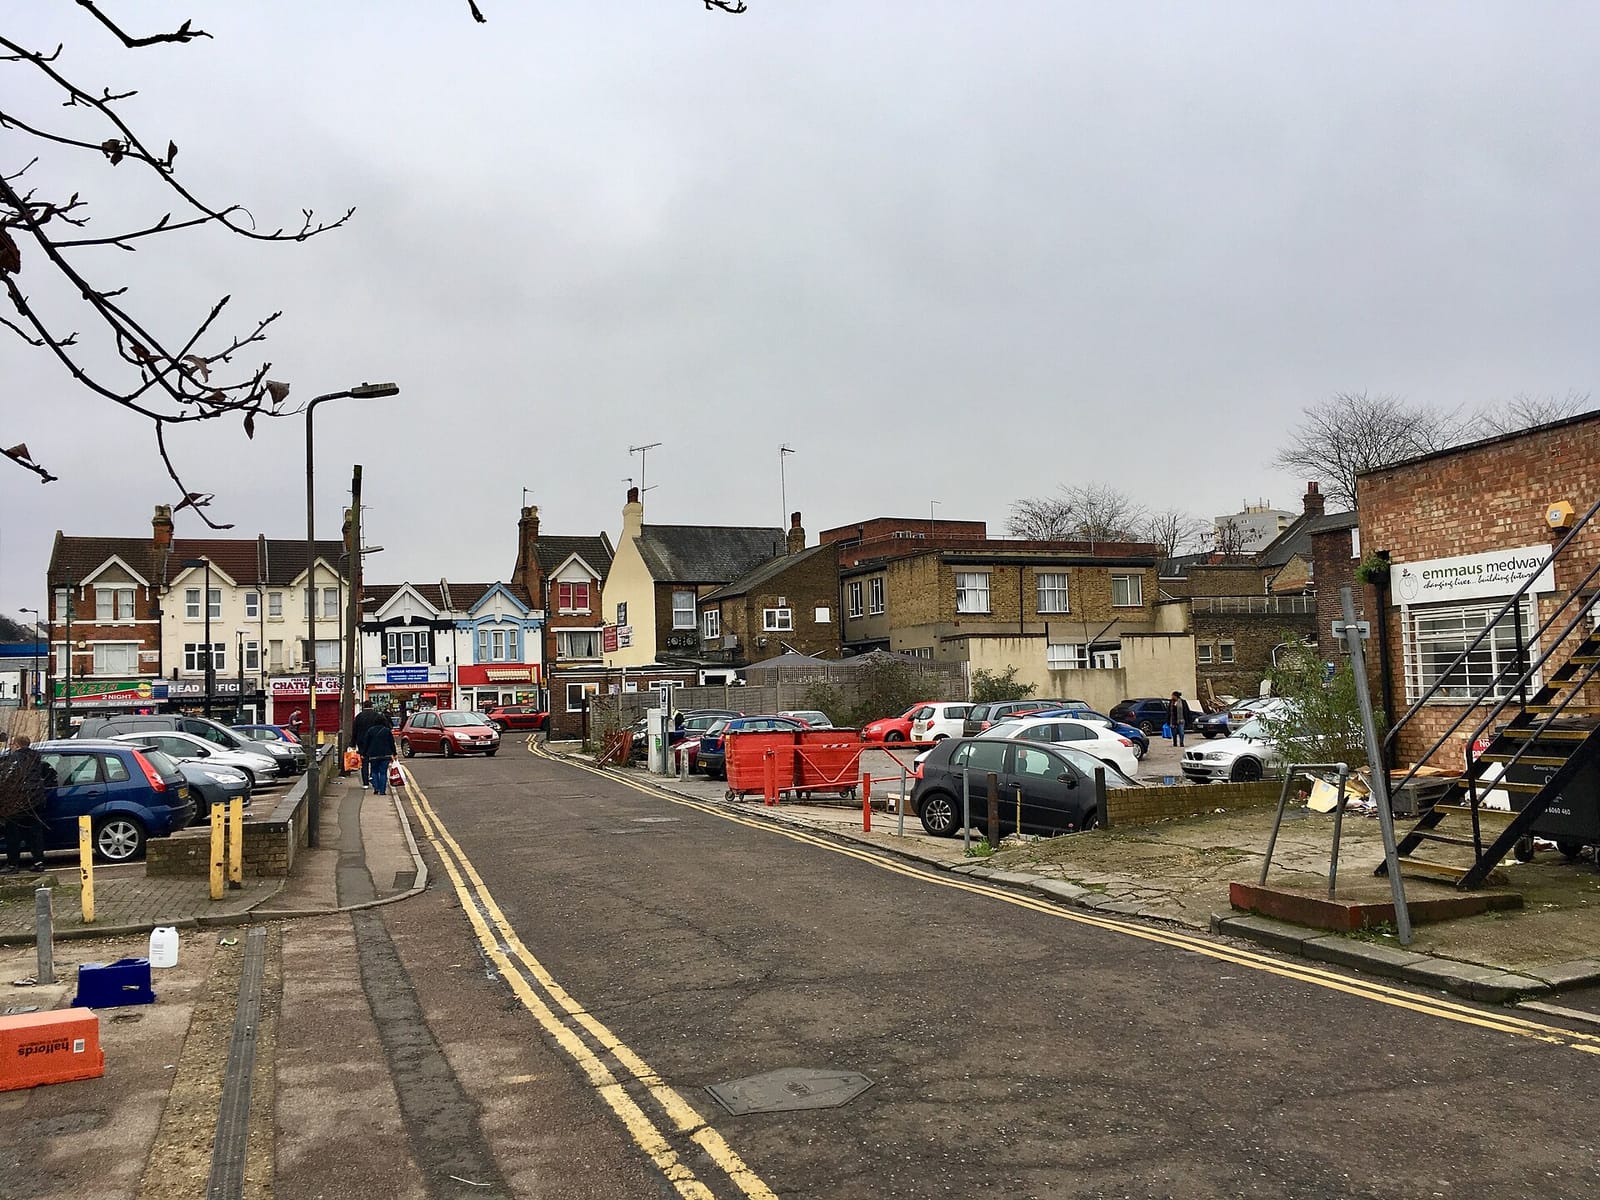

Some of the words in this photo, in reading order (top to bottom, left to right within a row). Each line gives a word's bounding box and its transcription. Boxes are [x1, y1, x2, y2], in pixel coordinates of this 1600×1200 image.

[1422, 564, 1483, 580] emmaus
[1486, 556, 1545, 573] medway
[1423, 579, 1453, 590] changing
[1478, 574, 1508, 584] building
[168, 684, 200, 692] HEAD
[273, 682, 322, 690] CHATHM
